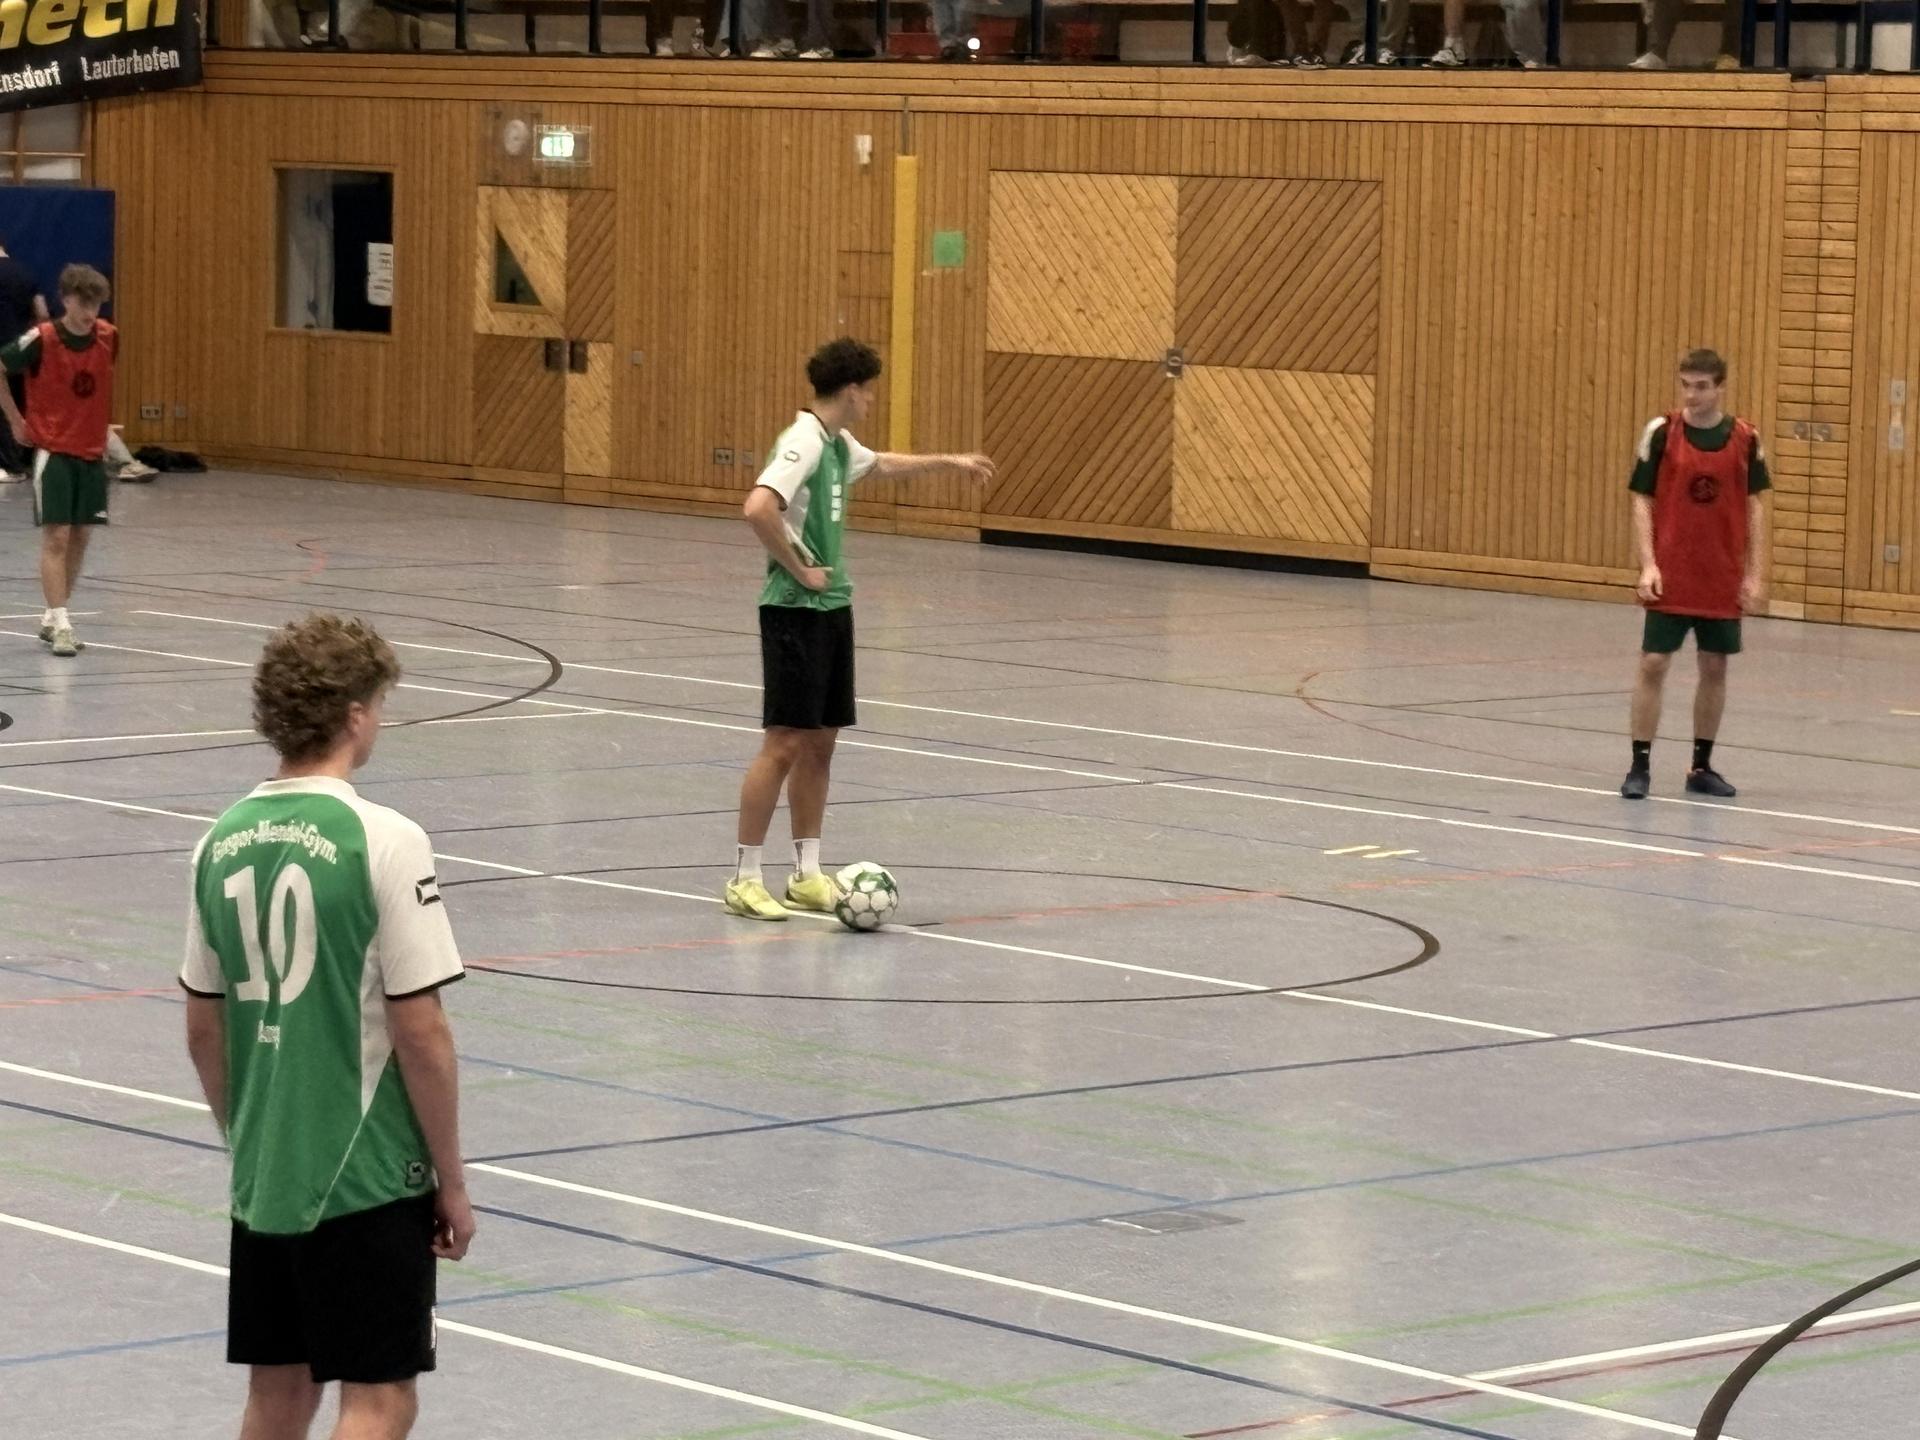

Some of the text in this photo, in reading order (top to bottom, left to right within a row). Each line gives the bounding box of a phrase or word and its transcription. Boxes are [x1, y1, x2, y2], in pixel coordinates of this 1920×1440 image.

[0, 46, 180, 93] nsdorf Lauterhofen
[223, 862, 318, 1005] 10
